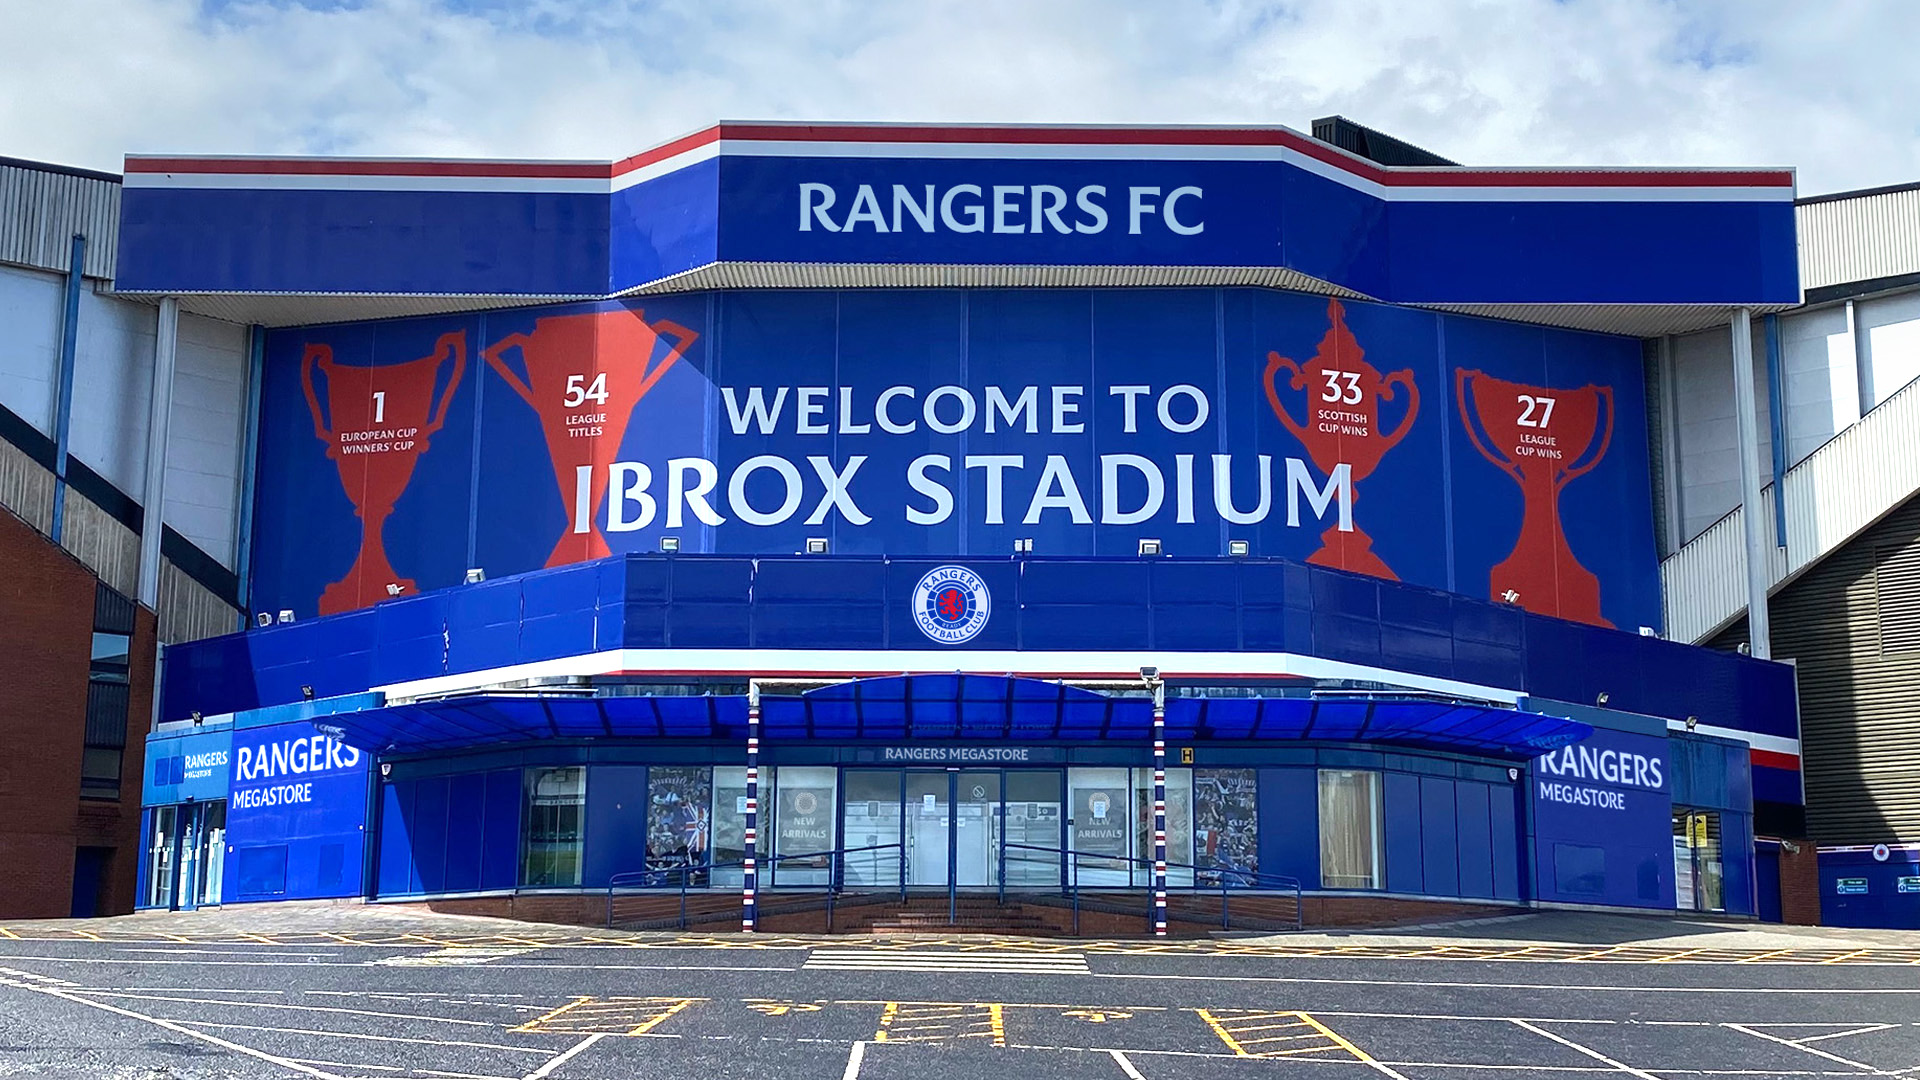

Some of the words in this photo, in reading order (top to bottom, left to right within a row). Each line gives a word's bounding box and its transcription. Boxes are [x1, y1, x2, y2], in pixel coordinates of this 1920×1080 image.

[798, 182, 1109, 235] RANGERS
[1128, 185, 1204, 236] FC
[563, 372, 610, 408] 54
[1321, 369, 1363, 405] 33
[373, 391, 385, 423] 1
[720, 384, 1086, 436] WELCOME
[1109, 384, 1210, 434] TO
[1516, 394, 1556, 429] 27
[566, 413, 607, 425] LEAGUE
[1318, 409, 1368, 424] SCOTTISH
[340, 429, 395, 442] EUROPEAN
[396, 427, 418, 439] CUP
[568, 426, 604, 438] TITLES
[1318, 422, 1339, 433] CUP
[1341, 424, 1368, 437] WINS
[393, 440, 415, 451] CUP
[1520, 433, 1557, 446] LEAGUE
[1515, 445, 1535, 456] CUP
[1536, 447, 1563, 460] WINS
[573, 455, 873, 532] IBROX
[905, 452, 1356, 533] STADIUM
[922, 570, 981, 592] RANGERS
[919, 611, 966, 639] FOOTBALL
[965, 610, 985, 633] CLUB
[185, 751, 228, 770] RANGERS
[885, 748, 947, 760] RANGERS
[949, 748, 1029, 761] MEGASTORE
[1182, 749, 1193, 762] H
[232, 782, 312, 809] MEGASTORE
[1540, 782, 1626, 810] MEGASTORE
[793, 816, 816, 826] NEW
[1088, 817, 1112, 826] NEW
[781, 828, 827, 839] ARRIVALS
[1077, 829, 1123, 839] ARRIVALS
